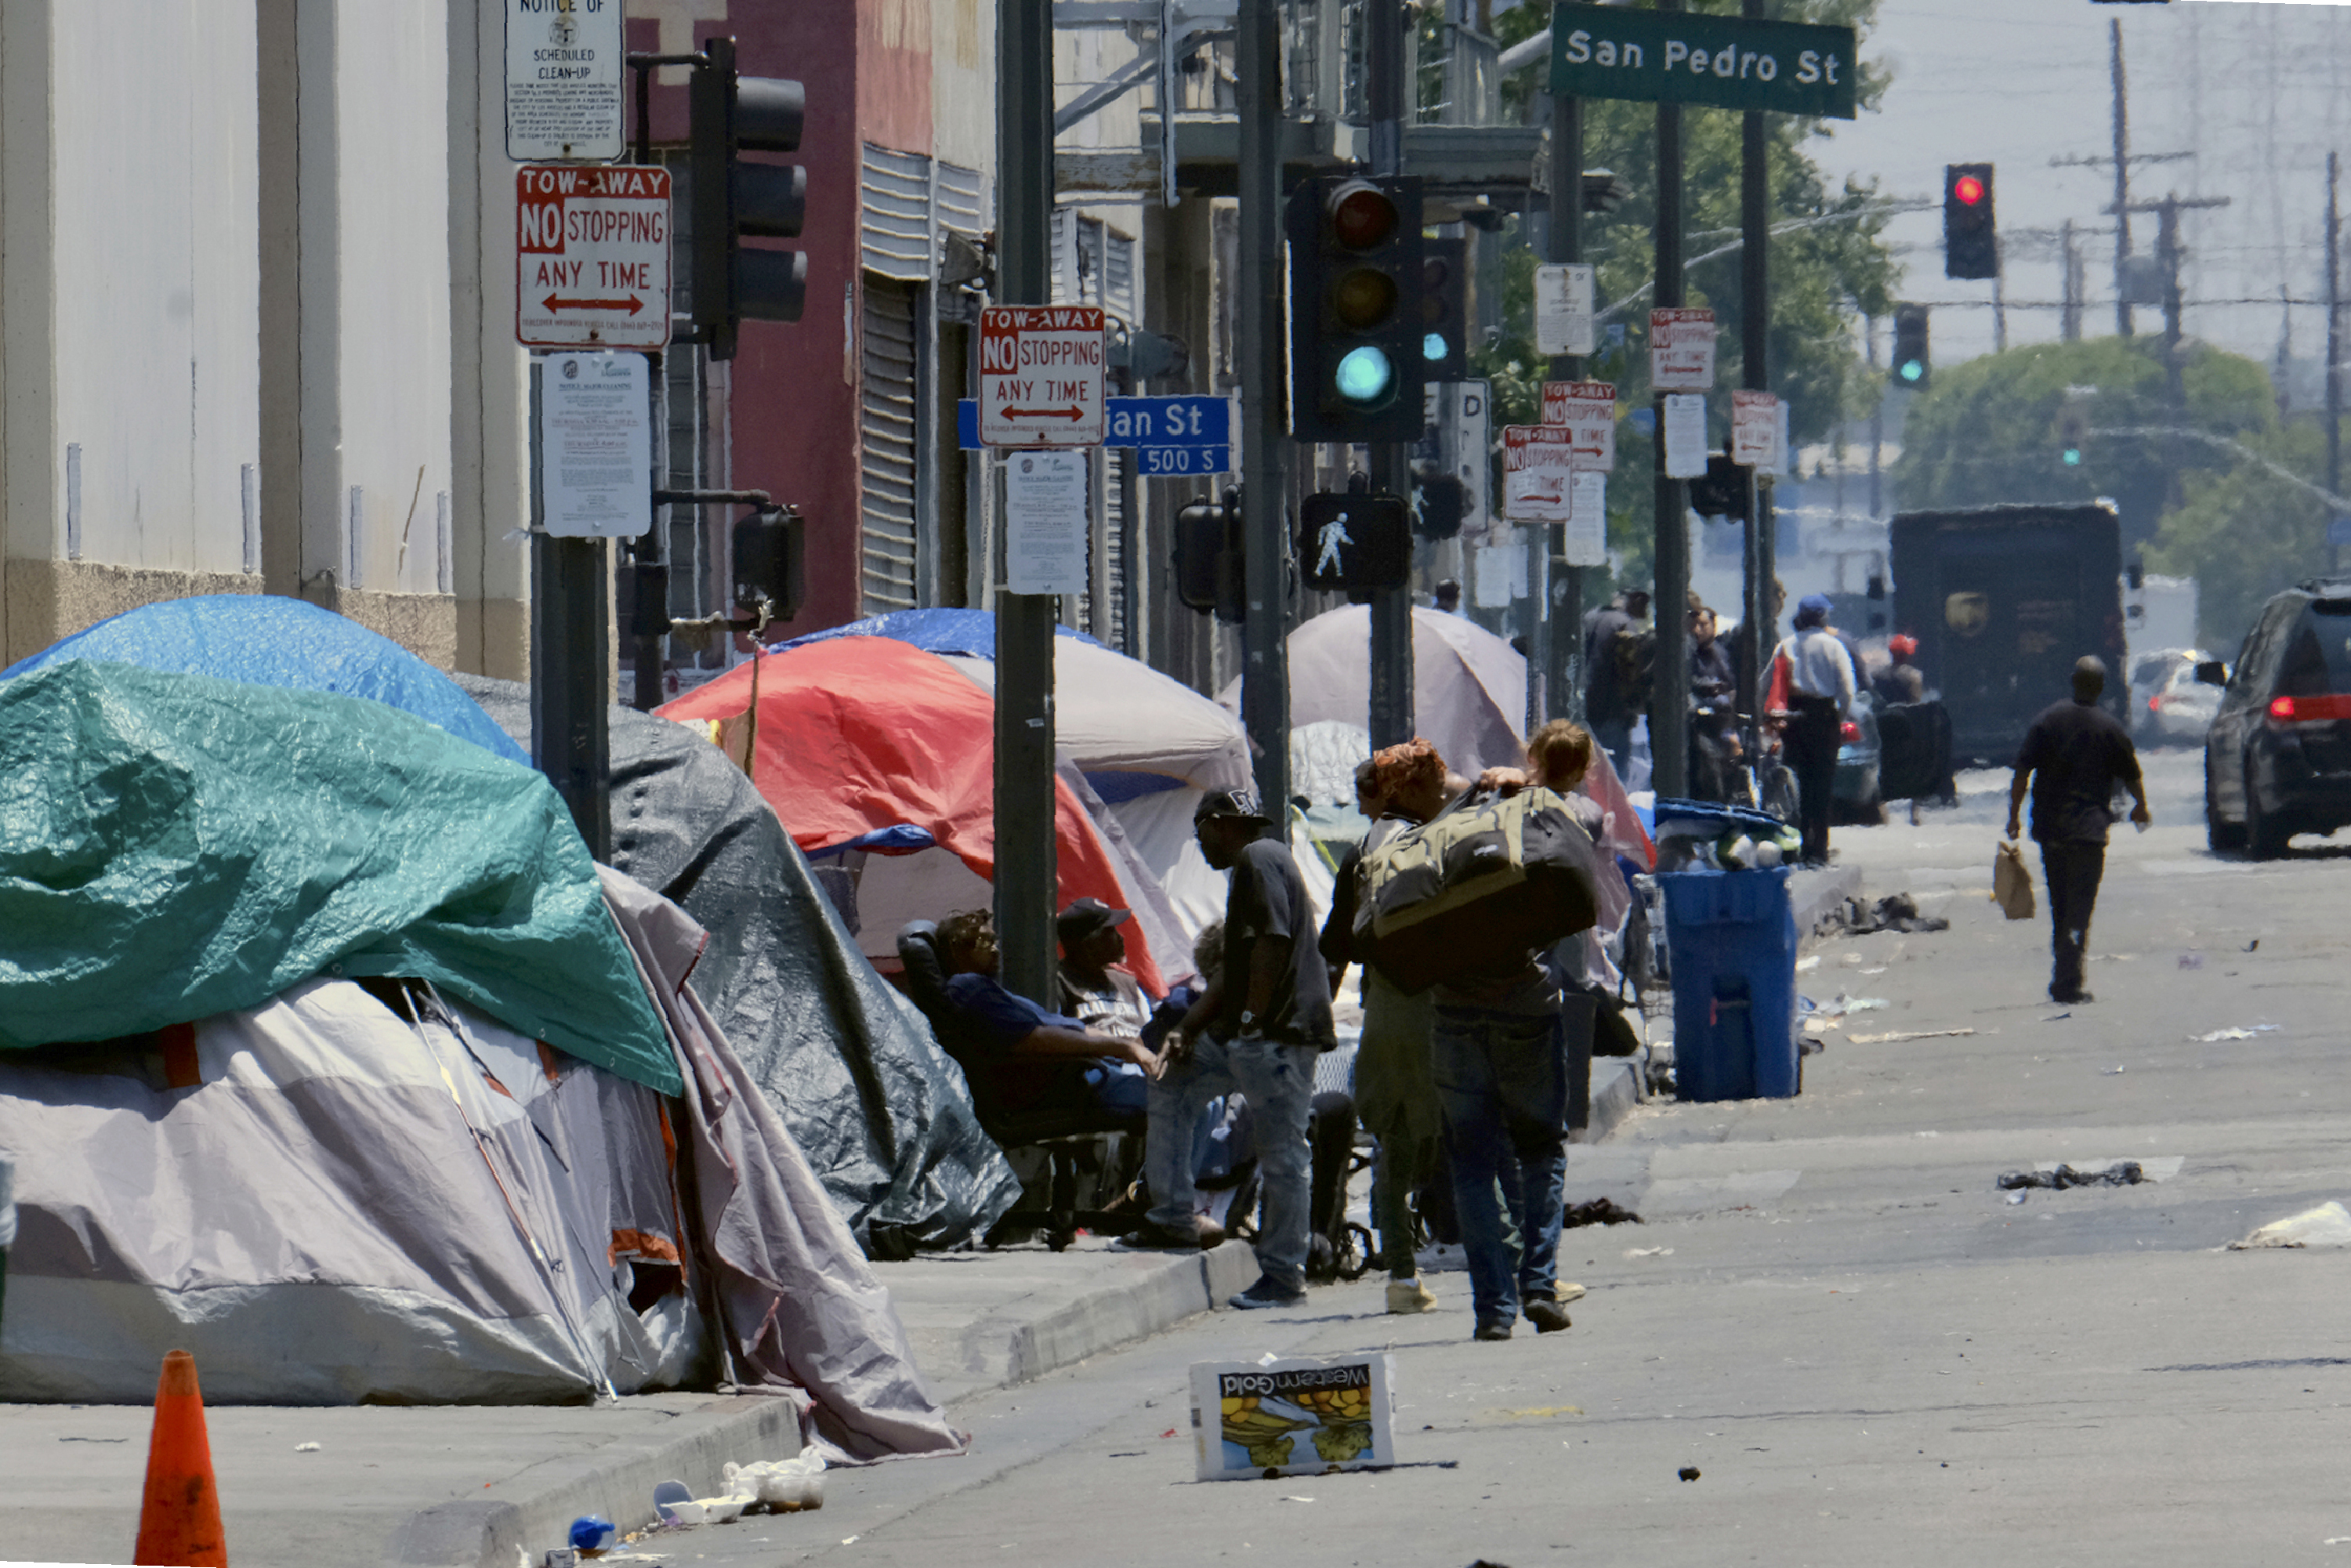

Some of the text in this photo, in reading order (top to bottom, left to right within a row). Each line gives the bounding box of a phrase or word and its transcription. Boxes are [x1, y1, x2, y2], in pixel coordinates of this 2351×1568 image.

[534, 49, 595, 61] SCHEDULED
[1566, 30, 1840, 85] San Pedro St
[538, 67, 591, 79] CLEAN-UP
[522, 170, 665, 194] TOW-AWAY
[521, 202, 663, 248] NO STOPPING
[535, 261, 651, 290] ANY TIME
[985, 310, 1100, 328] TOW-AWAY
[983, 335, 1099, 371] NO STOPPING
[996, 380, 1089, 401] ANY TIME
[1105, 404, 1203, 437] ian St
[1545, 400, 1613, 423] NO STOPPING
[1581, 429, 1606, 443] TIME
[1147, 449, 1214, 472] 500 S
[1506, 447, 1525, 470] NO
[1539, 475, 1564, 492] TIME
